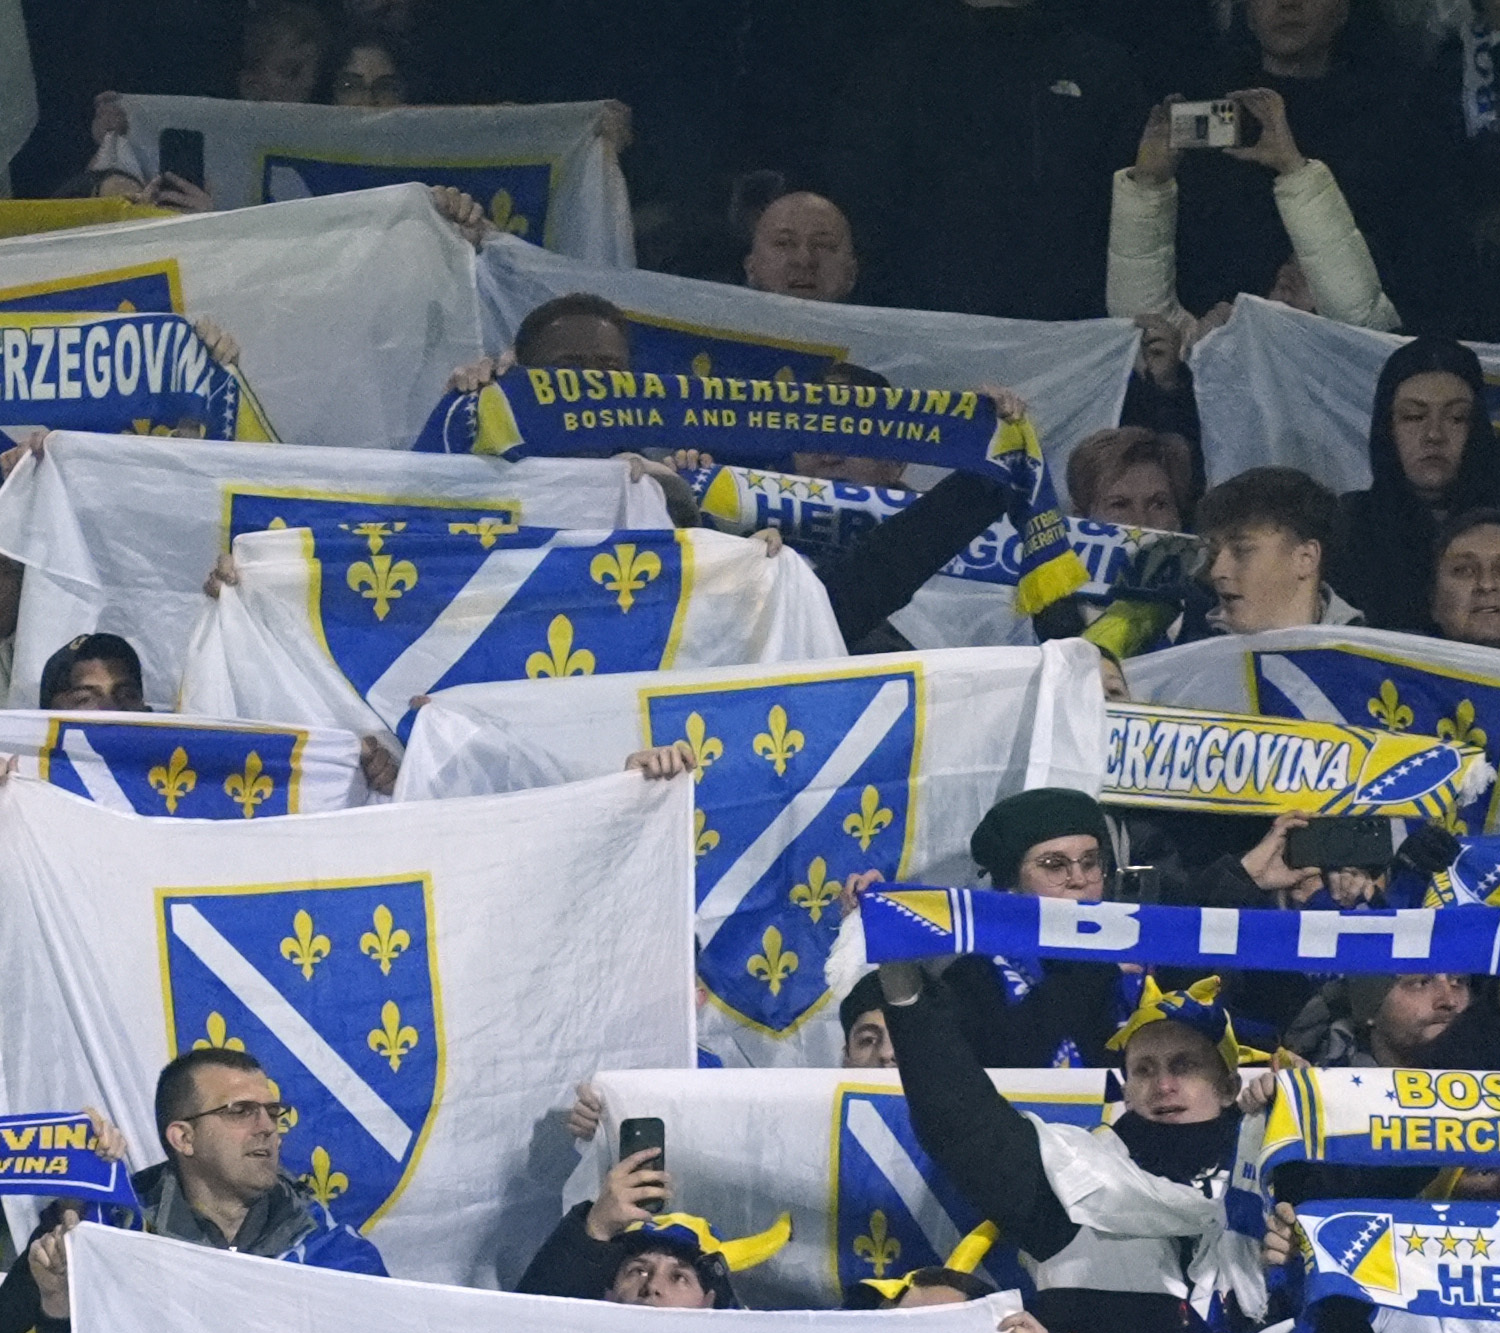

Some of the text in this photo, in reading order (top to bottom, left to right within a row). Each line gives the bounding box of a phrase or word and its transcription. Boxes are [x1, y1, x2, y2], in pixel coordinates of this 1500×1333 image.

[528, 368, 665, 405] BOSNA
[564, 408, 942, 445] BOSNIA AND HERZEGOVINA
[1106, 717, 1350, 795] ERZEGOVINA
